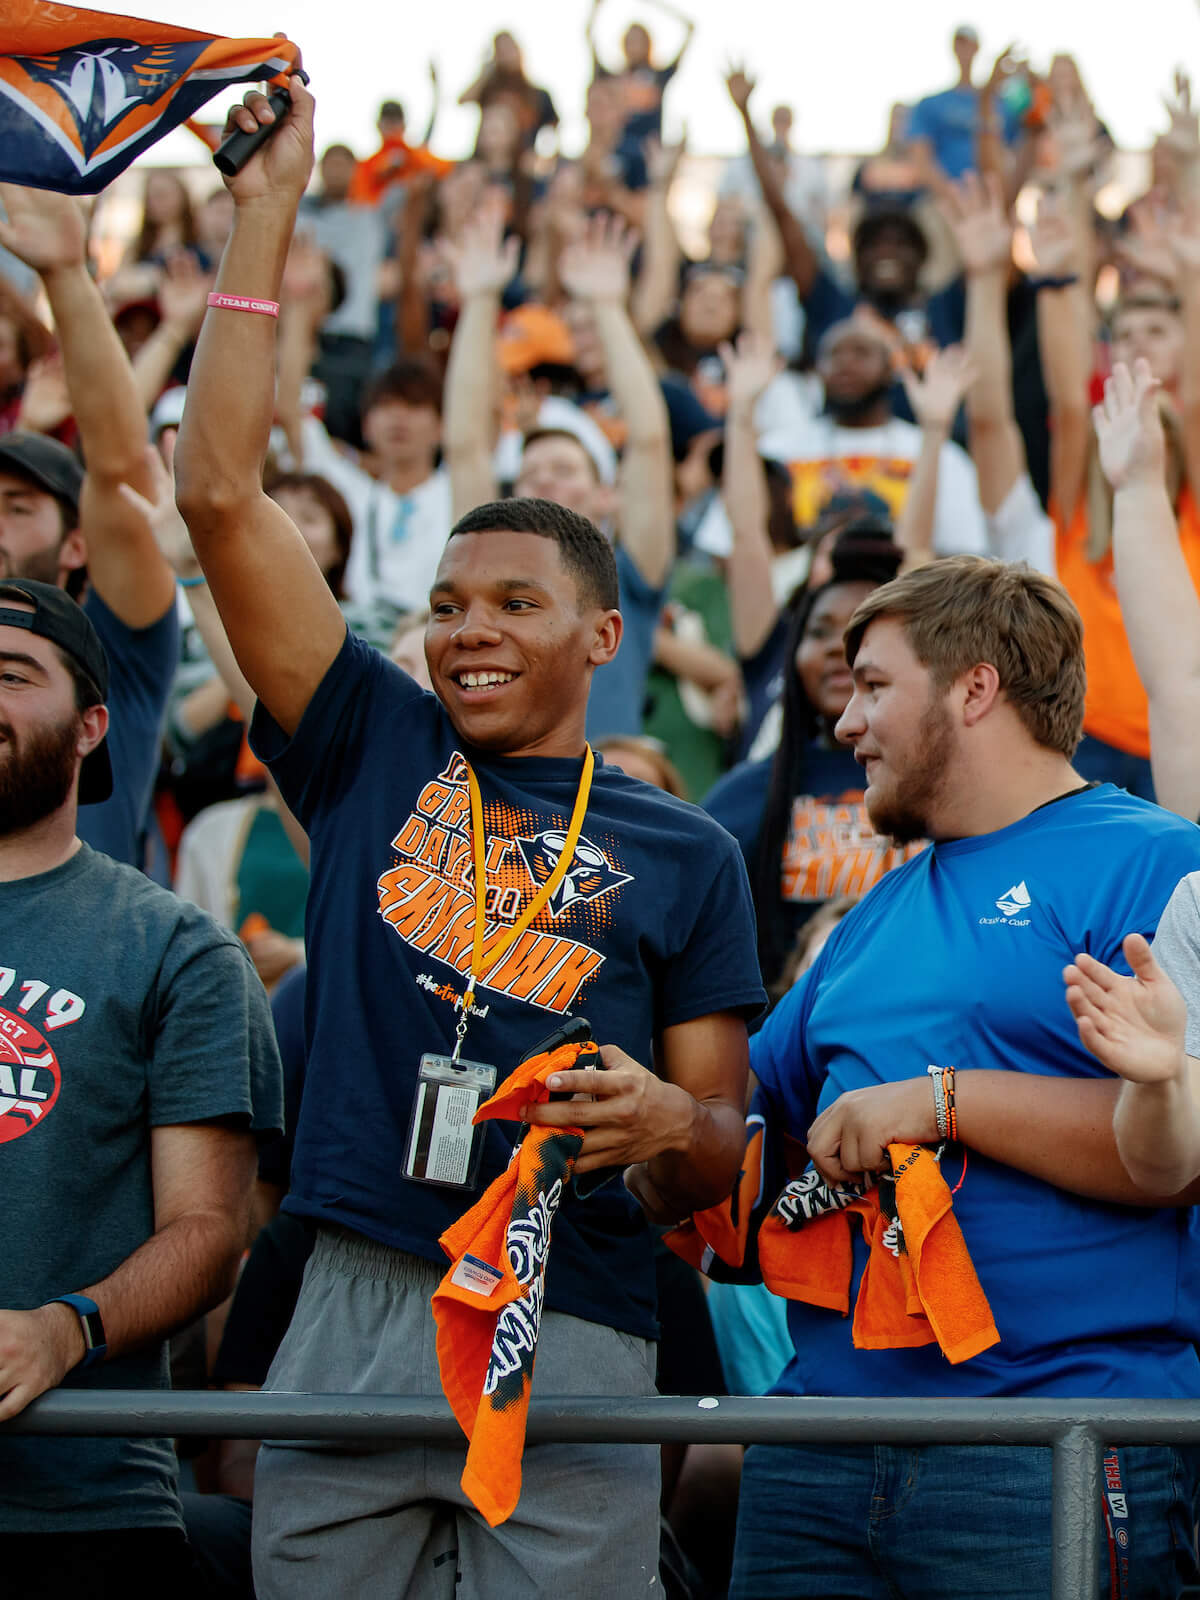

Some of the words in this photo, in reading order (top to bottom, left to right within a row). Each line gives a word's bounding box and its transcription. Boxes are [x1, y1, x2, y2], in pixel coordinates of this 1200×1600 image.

[223, 298, 250, 308] TEAM
[391, 814, 473, 877] DAY
[417, 781, 514, 873] GRT
[377, 864, 607, 1015] SKYHAWK
[416, 973, 489, 1018] #beutmpoud
[1104, 1455, 1122, 1490] THE
